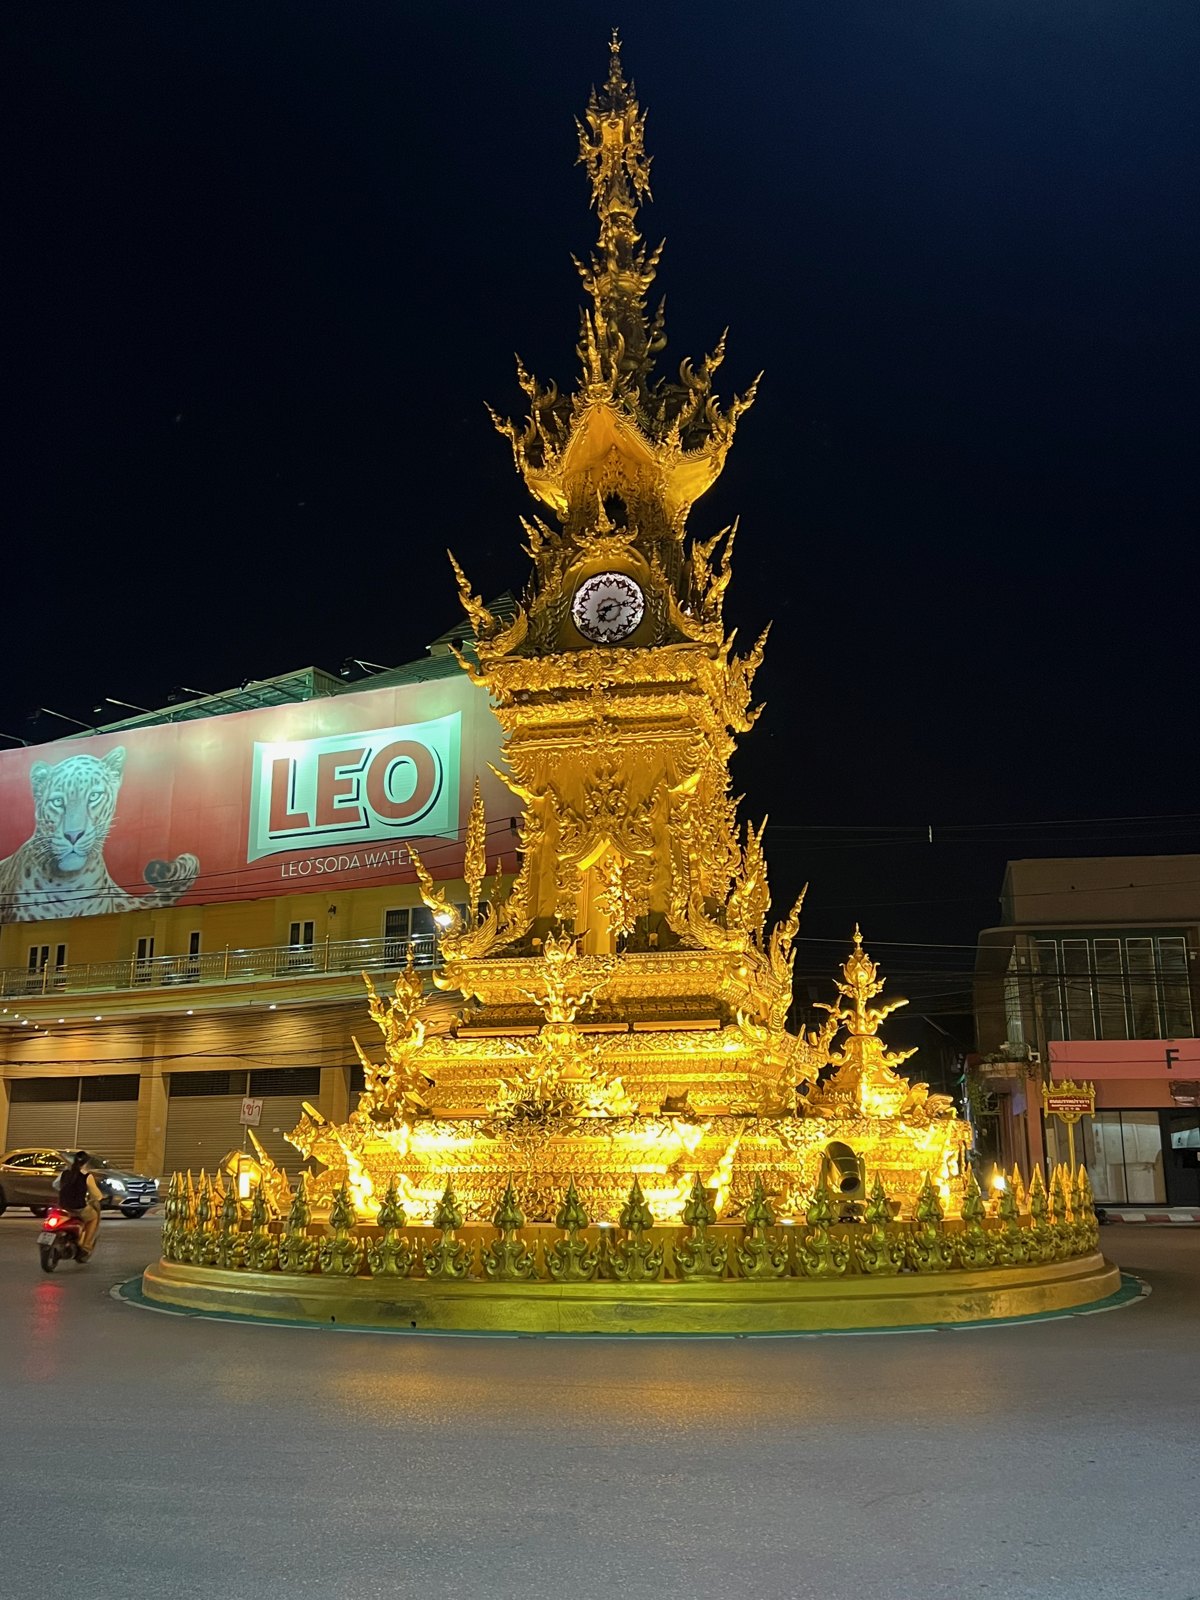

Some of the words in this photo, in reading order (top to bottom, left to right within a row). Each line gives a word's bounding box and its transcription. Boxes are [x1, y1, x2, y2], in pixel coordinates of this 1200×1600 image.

[269, 740, 440, 835] LEO
[281, 861, 311, 877] LEO
[315, 856, 361, 873] SODA
[1165, 1048, 1179, 1069] F
